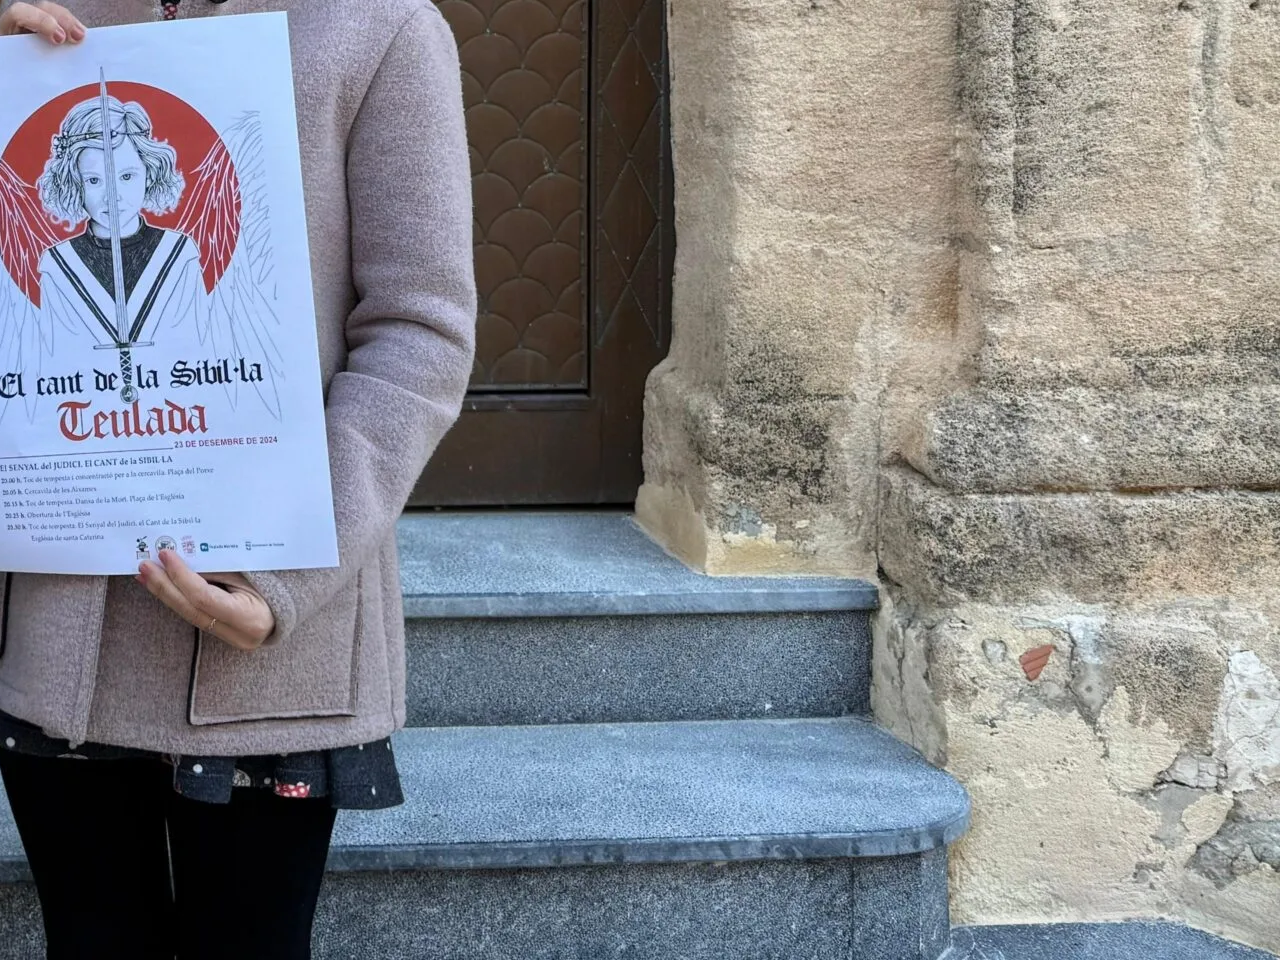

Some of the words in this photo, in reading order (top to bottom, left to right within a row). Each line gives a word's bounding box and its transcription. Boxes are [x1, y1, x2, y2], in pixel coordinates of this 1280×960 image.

[36, 369, 84, 396] cant
[93, 368, 118, 391] de
[137, 365, 160, 390] la
[170, 358, 264, 388] Sibil·la
[57, 399, 209, 441] Teulada
[174, 441, 184, 449] 23
[198, 438, 244, 447] DESEMBRE
[246, 437, 259, 445] DE
[259, 436, 278, 444] 2024
[0, 464, 7, 472] El
[8, 463, 39, 472] SENYAL
[40, 462, 52, 470] del
[84, 460, 93, 468] El
[93, 458, 118, 467] CANT
[130, 457, 137, 465] la
